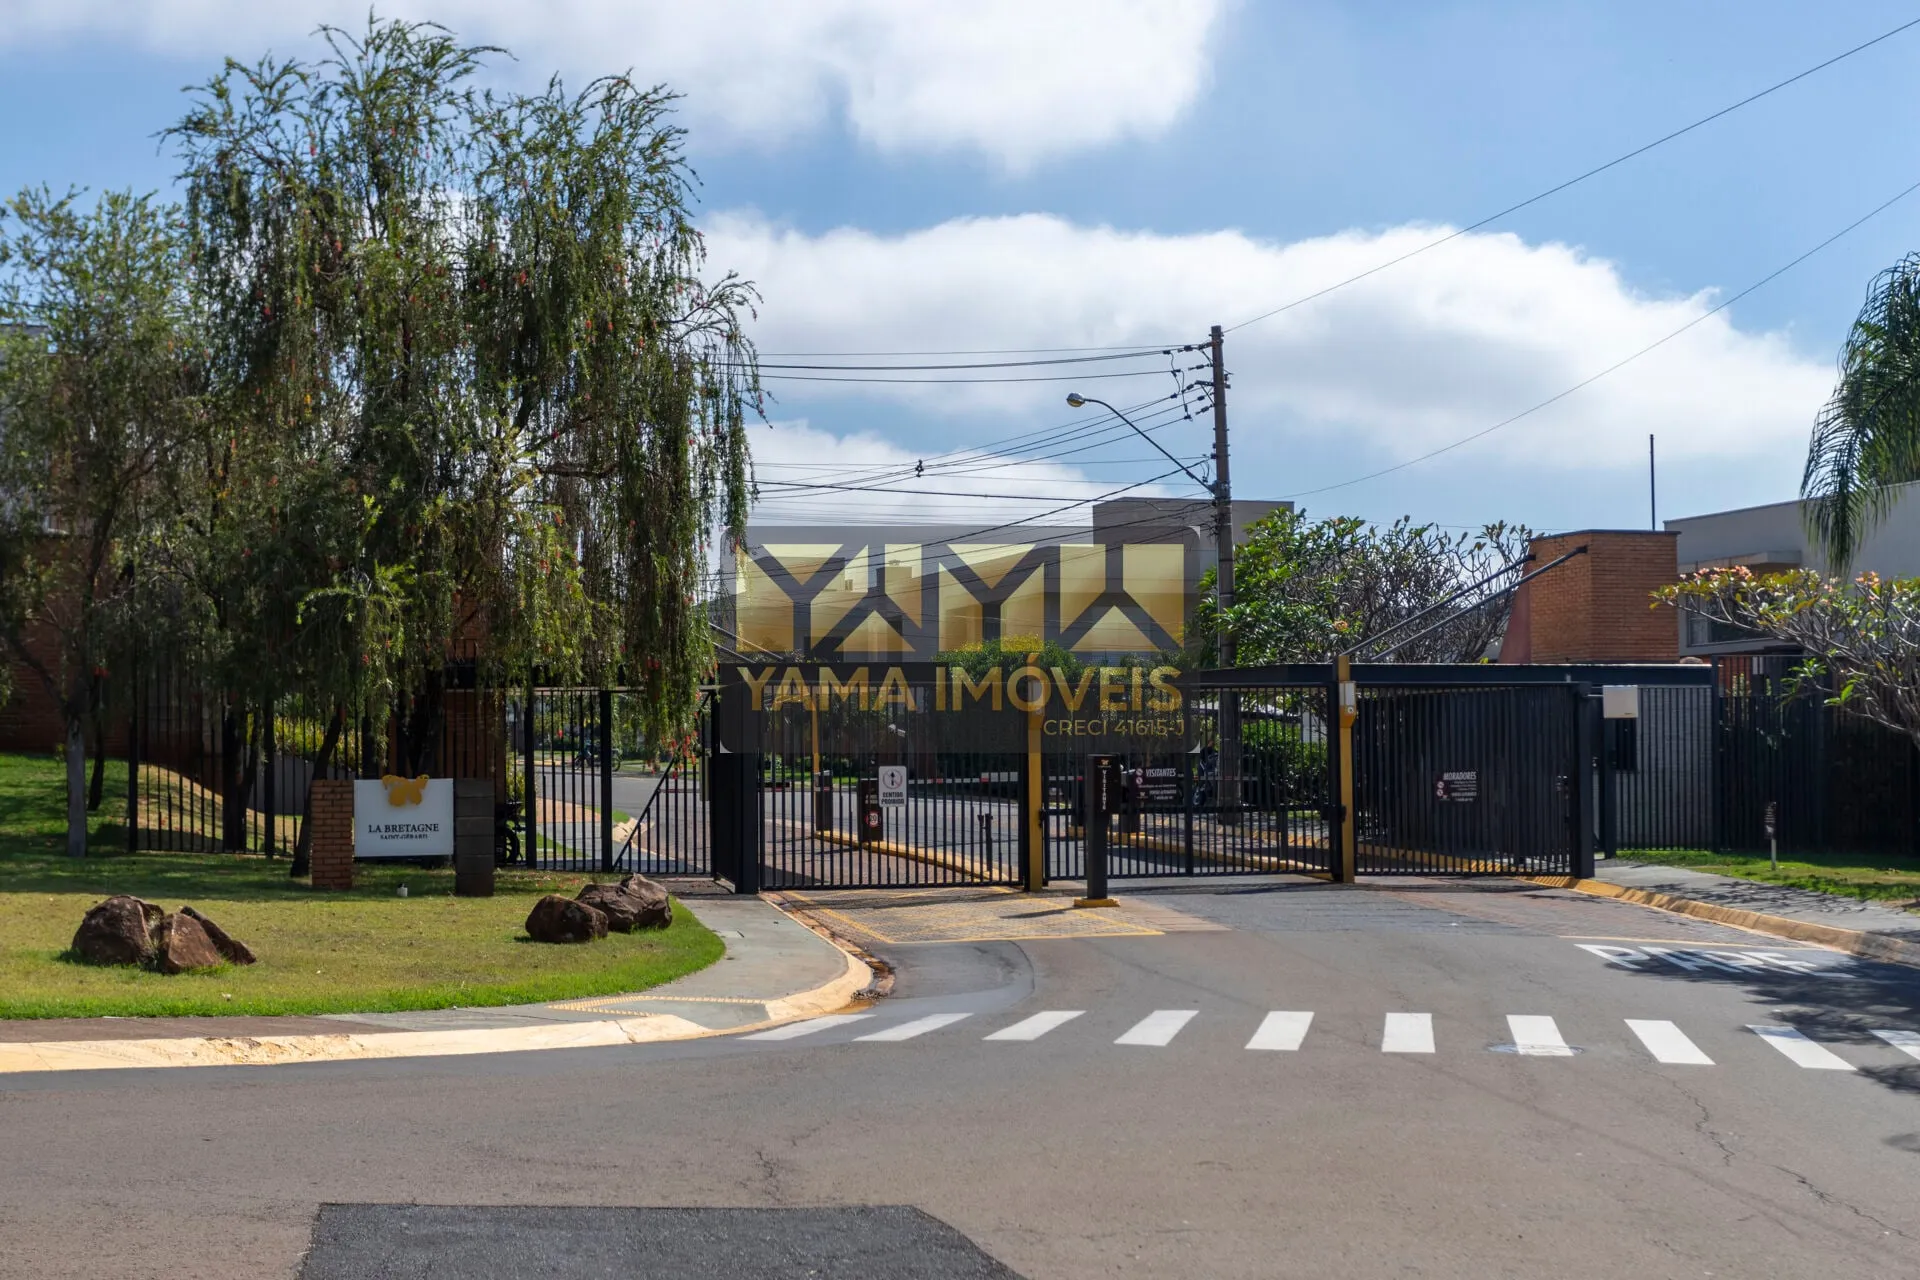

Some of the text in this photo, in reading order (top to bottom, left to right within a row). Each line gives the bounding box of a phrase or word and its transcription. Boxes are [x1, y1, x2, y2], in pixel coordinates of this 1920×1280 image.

[1145, 767, 1177, 777] VISITANTES
[368, 824, 439, 833] LA BRETAGNE
